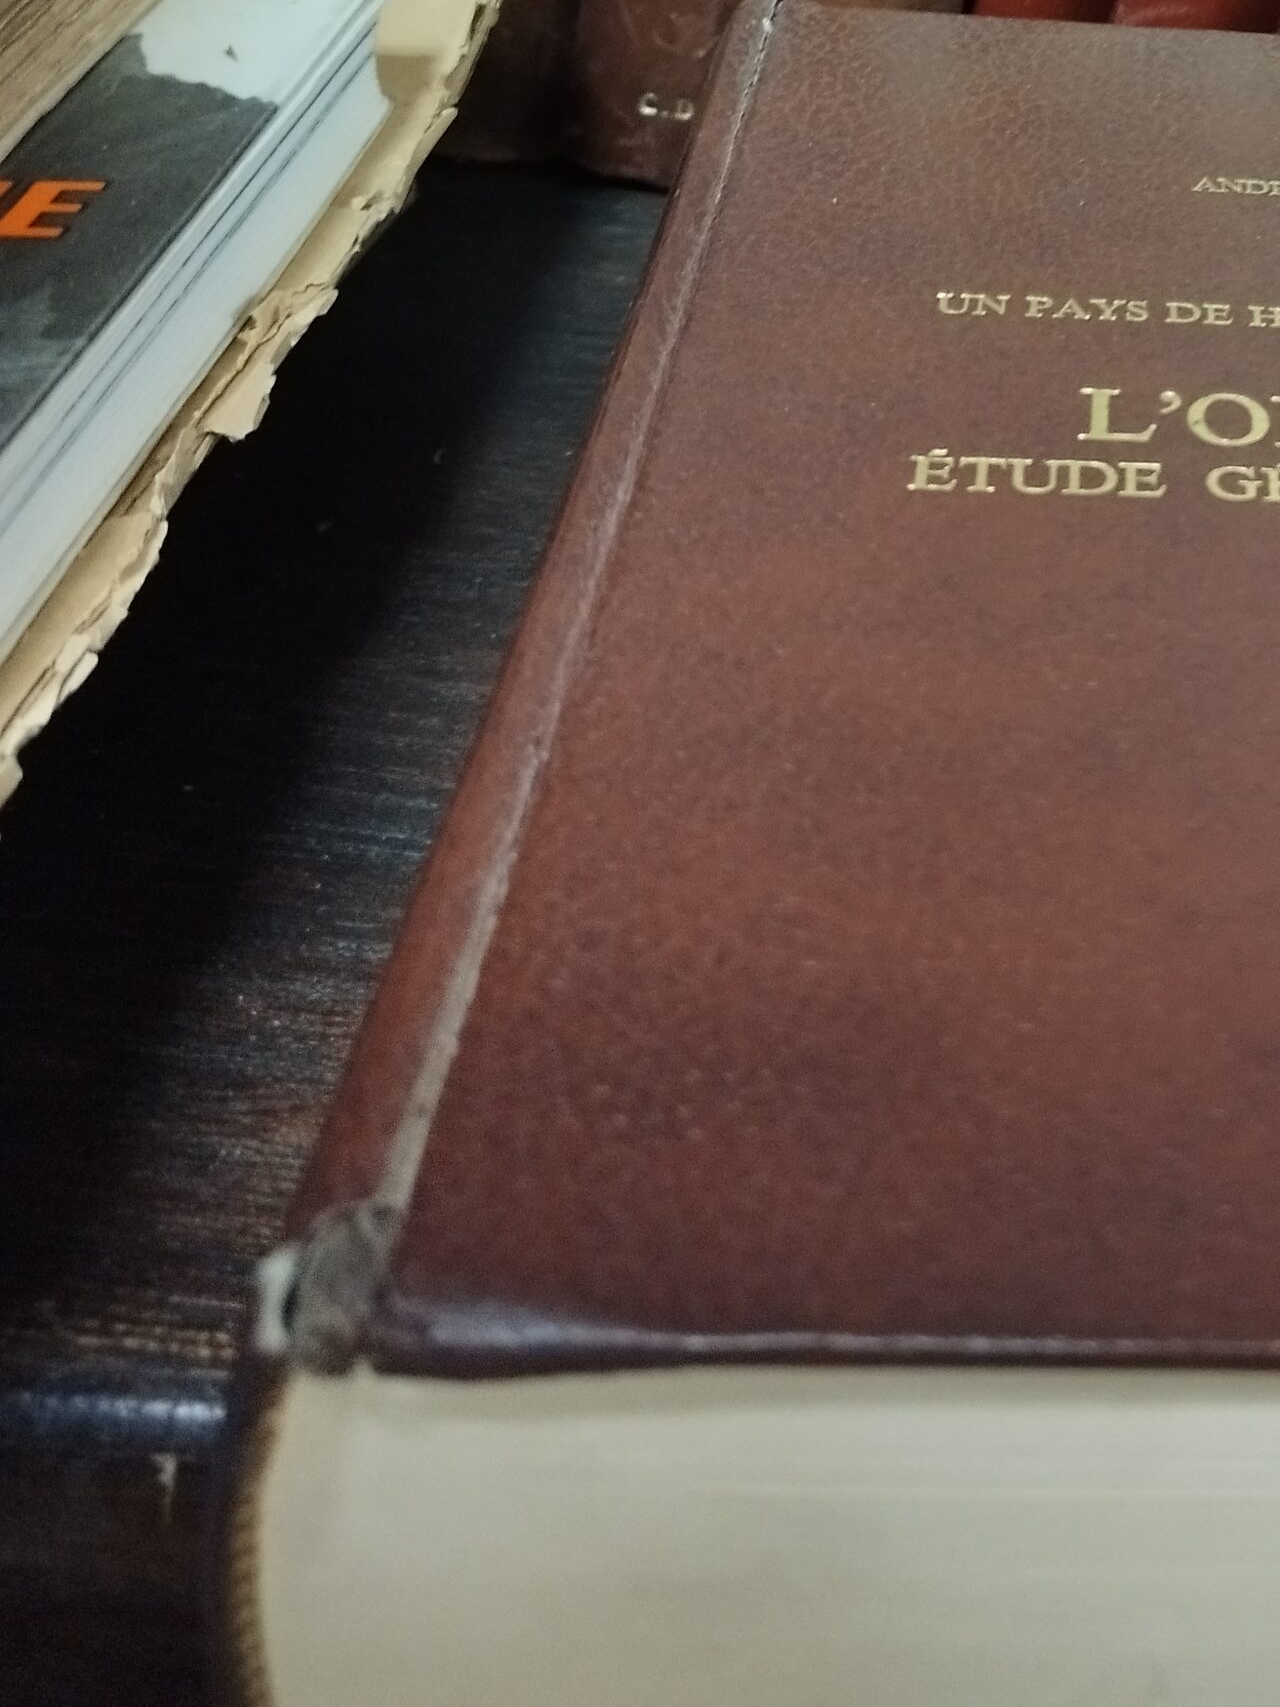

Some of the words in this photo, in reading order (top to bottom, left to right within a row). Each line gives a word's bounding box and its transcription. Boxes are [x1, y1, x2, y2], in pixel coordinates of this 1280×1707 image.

[0, 180, 106, 238] E
[936, 292, 1010, 317] UN
[1025, 296, 1149, 324] PAYS
[1165, 301, 1233, 328] DE
[907, 448, 1166, 497] ÉTUDE
